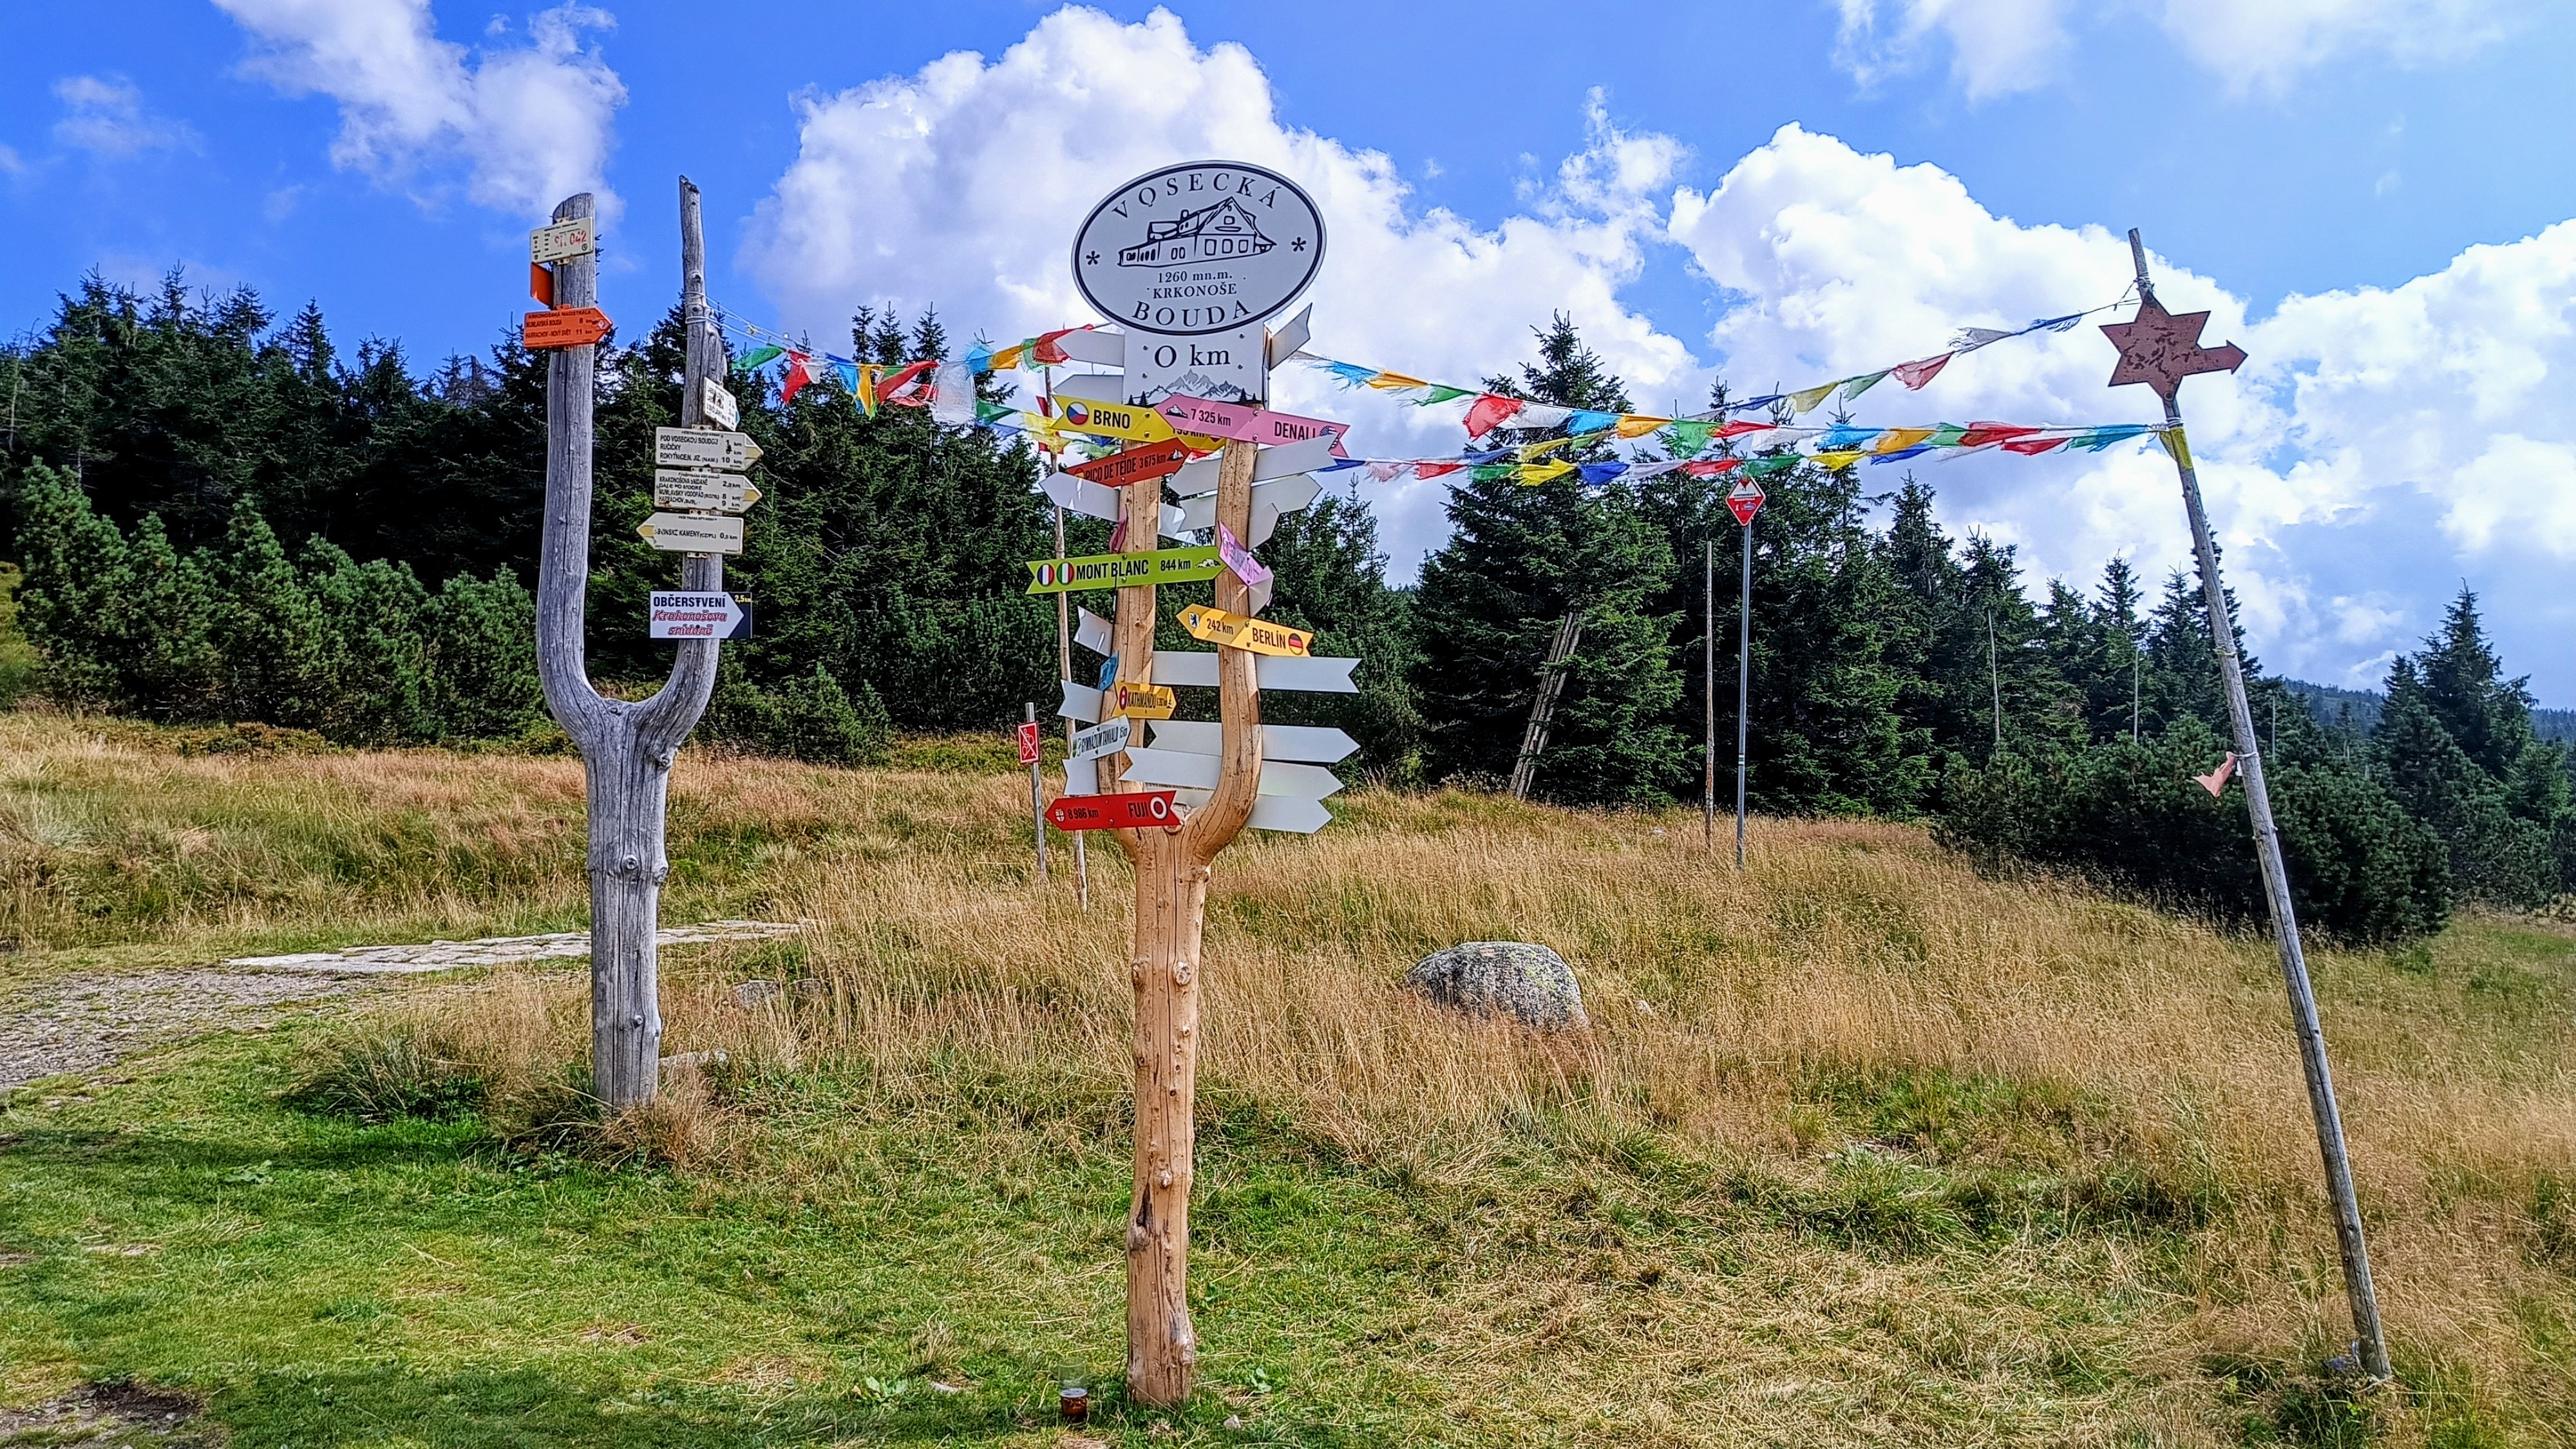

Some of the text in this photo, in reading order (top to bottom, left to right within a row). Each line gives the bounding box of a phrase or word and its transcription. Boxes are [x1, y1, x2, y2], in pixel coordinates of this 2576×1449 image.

[1159, 271, 1187, 283] 1260
[1153, 281, 1237, 299] KRKONOŠE
[1132, 299, 1251, 327] BOUDA
[1189, 344, 1231, 366] km
[1093, 409, 1131, 429] BRNO
[1218, 413, 1231, 426] km
[1085, 466, 1103, 482] PICO
[1104, 463, 1114, 479] DE
[1157, 453, 1166, 464] km
[1076, 558, 1191, 580] MONT BLANC 844 km
[653, 594, 727, 607] OBČERSTVENÍ
[652, 609, 728, 621] Krakonošova
[1206, 618, 1221, 632] 242
[1222, 621, 1234, 635] km
[1088, 807, 1099, 819] km
[1128, 801, 1150, 819] FUJI
